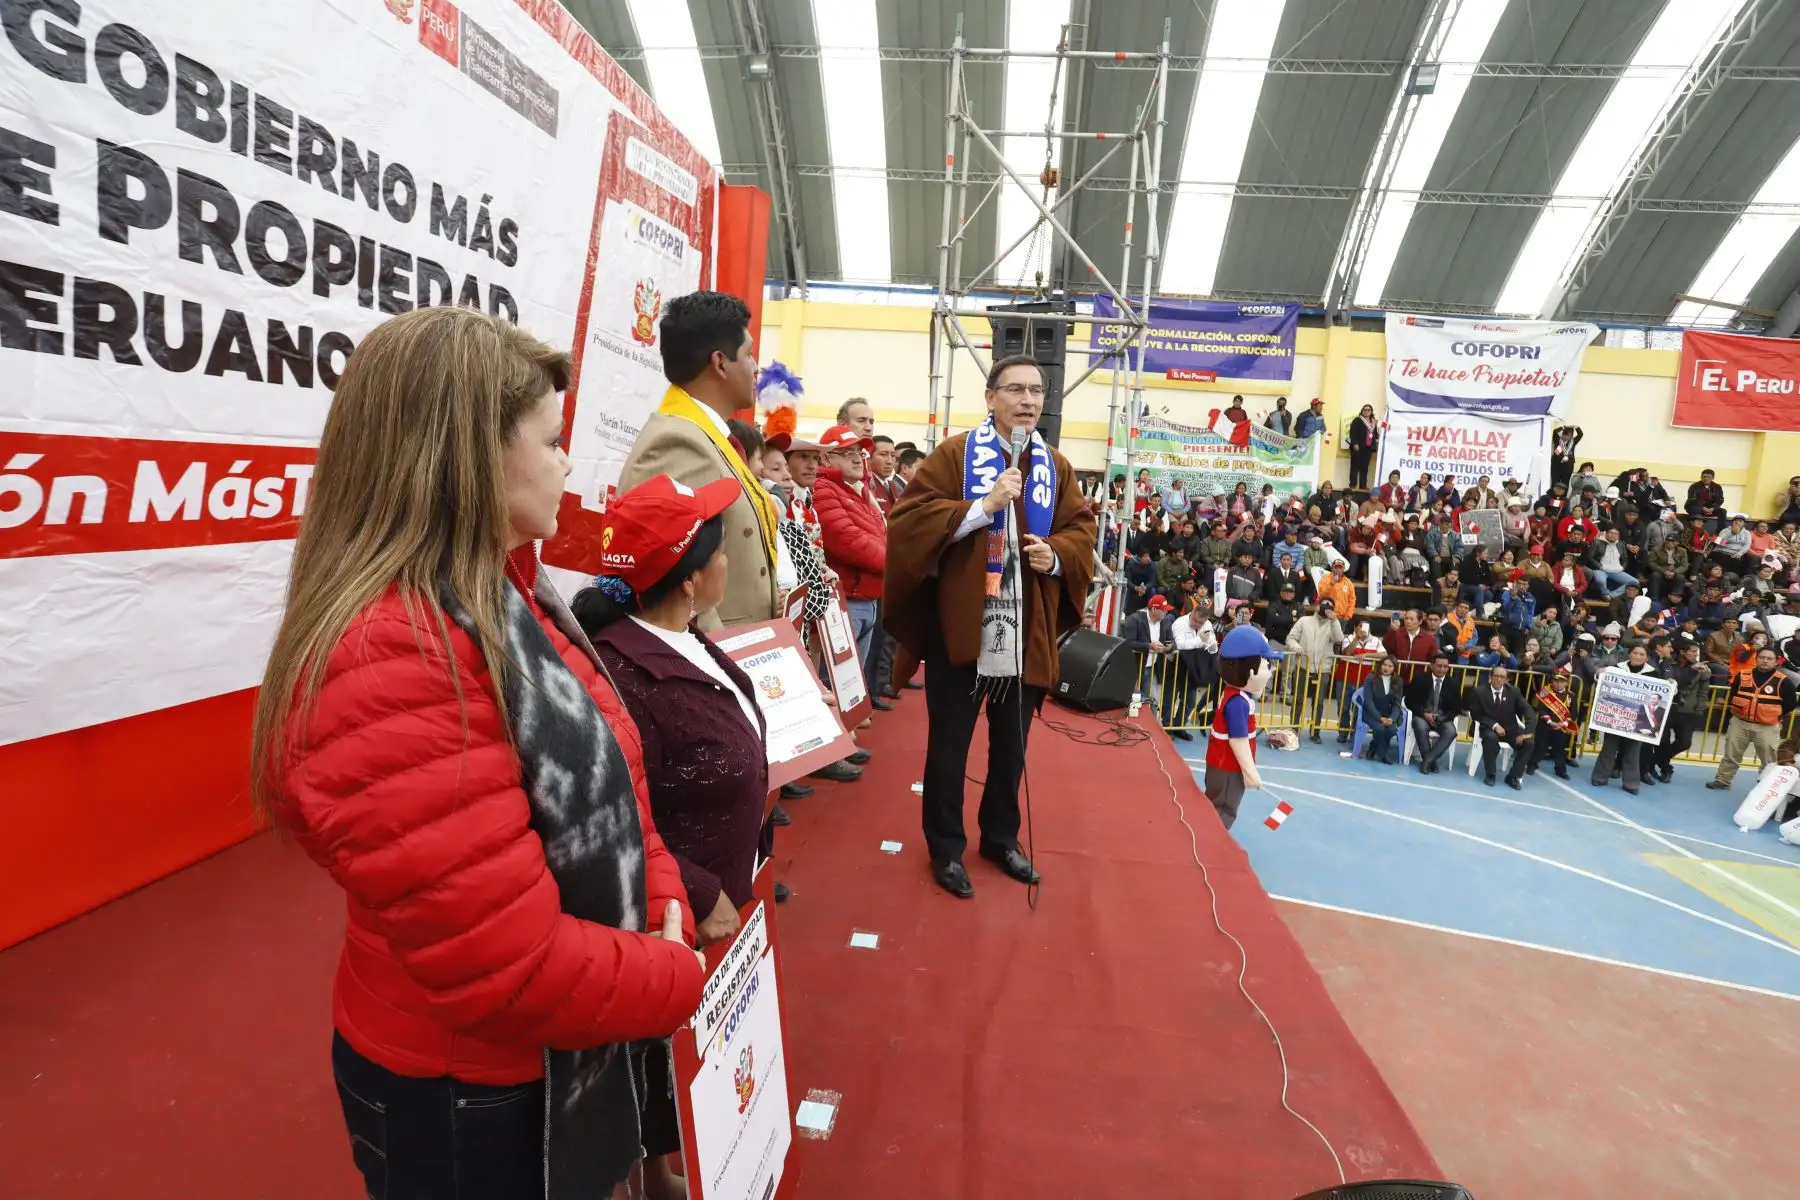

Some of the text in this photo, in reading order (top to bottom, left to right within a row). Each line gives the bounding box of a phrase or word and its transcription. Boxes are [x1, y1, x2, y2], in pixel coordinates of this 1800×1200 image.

[422, 8, 455, 43] PERÚ
[465, 18, 505, 64] Ministerio
[465, 40, 475, 57] de
[470, 61, 520, 104] Saneamiento
[0, 0, 520, 269] GOBIERNO MÁS
[97, 136, 518, 325] PROPIEDAD
[638, 213, 684, 260] COFOPRI
[1247, 305, 1285, 315] COFOPRI
[593, 333, 623, 358] Presidencia
[1165, 341, 1174, 350] A
[1175, 342, 1190, 351] LA
[1191, 343, 1286, 357] RECONSTRUCCIÓN
[1236, 333, 1281, 344] COFOPRI
[1450, 341, 1541, 360] COFOPRI
[1401, 359, 1420, 378] Te
[1423, 361, 1469, 382] hace
[1701, 368, 1731, 392] EL
[1406, 425, 1513, 449] HUAYLLAY
[1212, 456, 1229, 469] de
[1406, 442, 1506, 464] TE AGRADECE
[1399, 458, 1421, 470] POR
[1425, 460, 1445, 472] LOS
[1498, 466, 1513, 477] DE
[743, 650, 782, 670] COFOPRI
[1603, 674, 1670, 694] BIENVENIDO
[720, 957, 731, 980] DE
[730, 906, 764, 963] PROPIEDAD
[706, 935, 760, 1032] REGISTRADO
[723, 970, 760, 1042] COFOPRI
